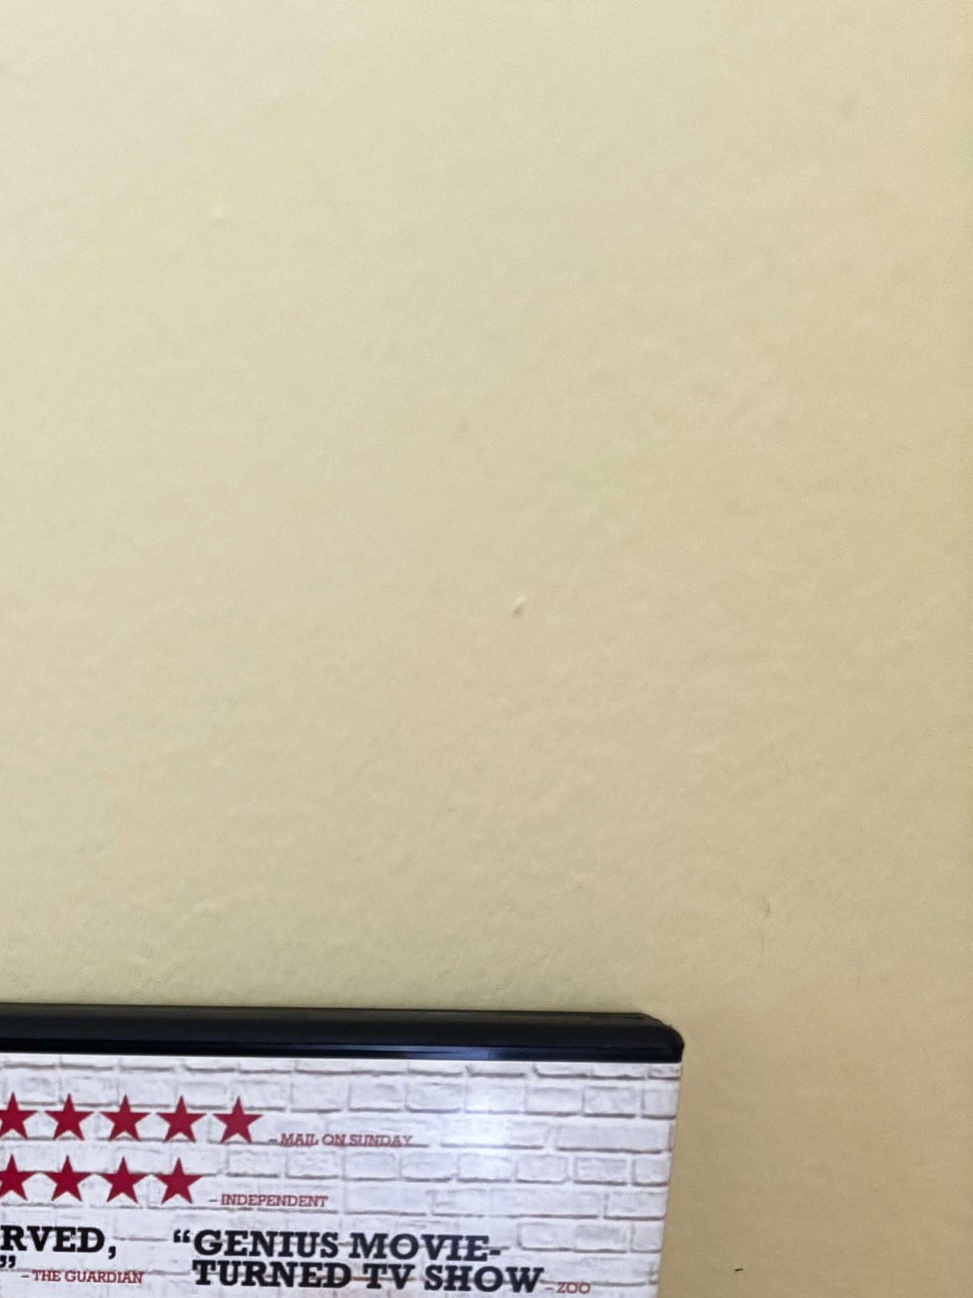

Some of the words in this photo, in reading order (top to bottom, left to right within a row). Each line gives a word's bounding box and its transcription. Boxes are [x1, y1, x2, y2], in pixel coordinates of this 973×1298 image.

[281, 1133, 318, 1146] MAIL
[322, 1134, 345, 1146] ON
[349, 1135, 412, 1147] SUNDAY
[221, 1194, 328, 1208] INDEPENDENT
[173, 1229, 338, 1258] “GENIUS
[350, 1233, 501, 1262] MOVIE-
[33, 1269, 60, 1282] THE
[64, 1269, 143, 1285] GUARDIAN
[192, 1260, 351, 1288] TURNED
[362, 1264, 414, 1289] TV
[557, 1281, 590, 1294] ZOO
